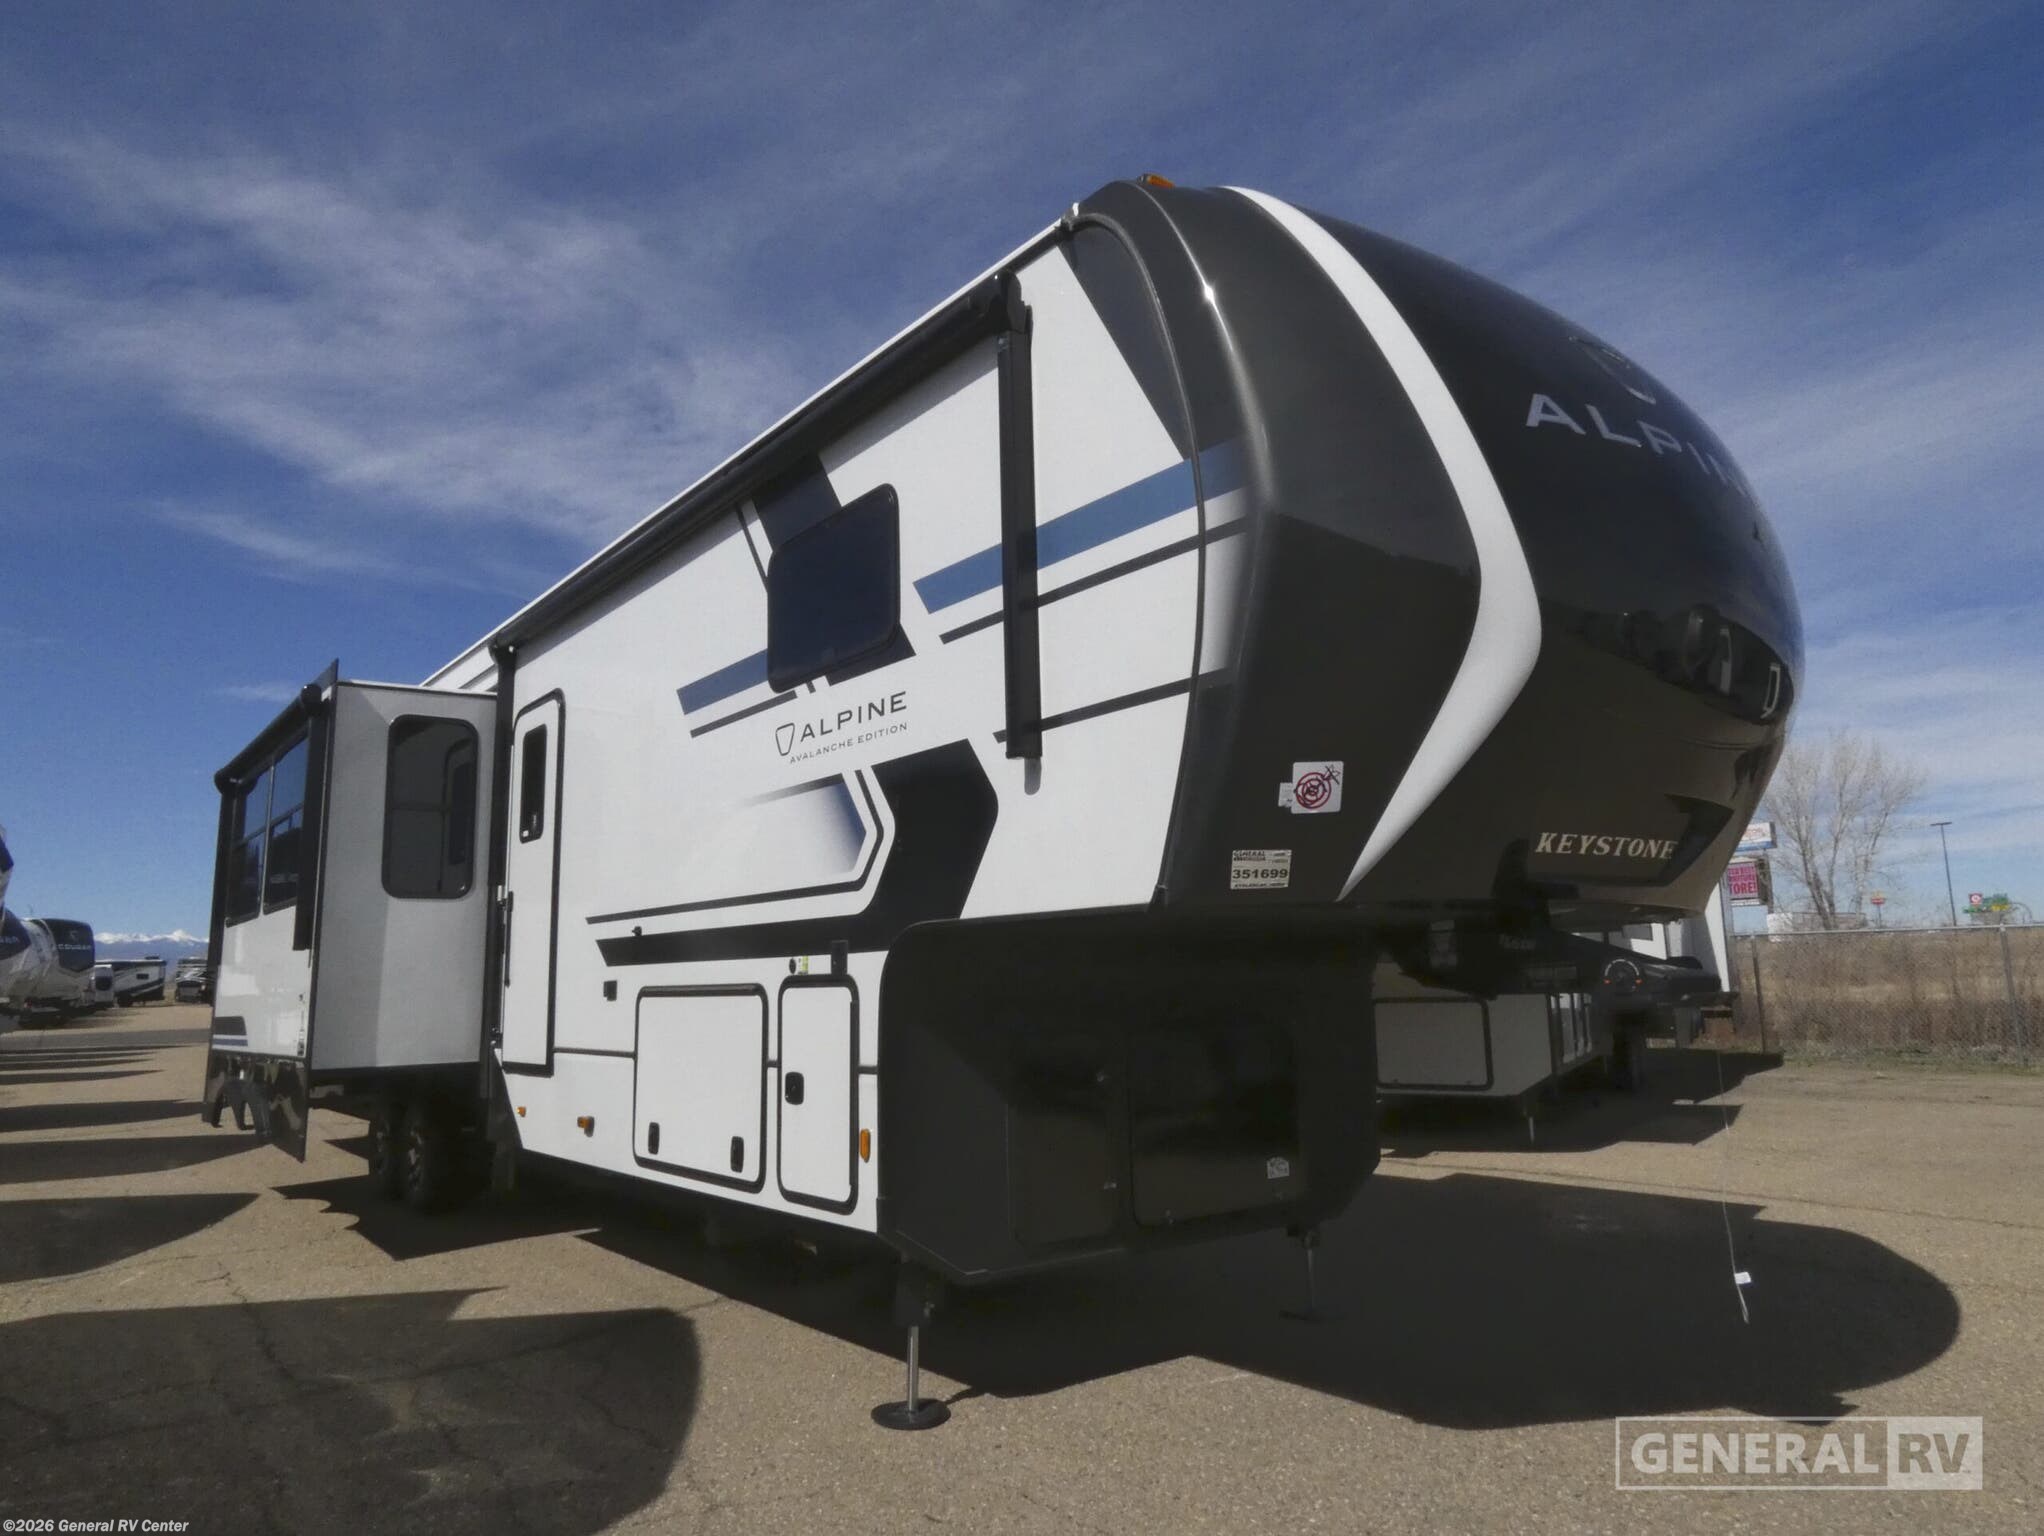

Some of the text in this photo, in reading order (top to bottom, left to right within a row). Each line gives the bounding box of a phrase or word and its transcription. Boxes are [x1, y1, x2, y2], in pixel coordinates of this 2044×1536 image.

[800, 691, 907, 743] ALPINE
[790, 722, 908, 764] AVALANCHE EDITION
[1535, 832, 1679, 860] KEYSTONE
[1232, 868, 1288, 879] 351699
